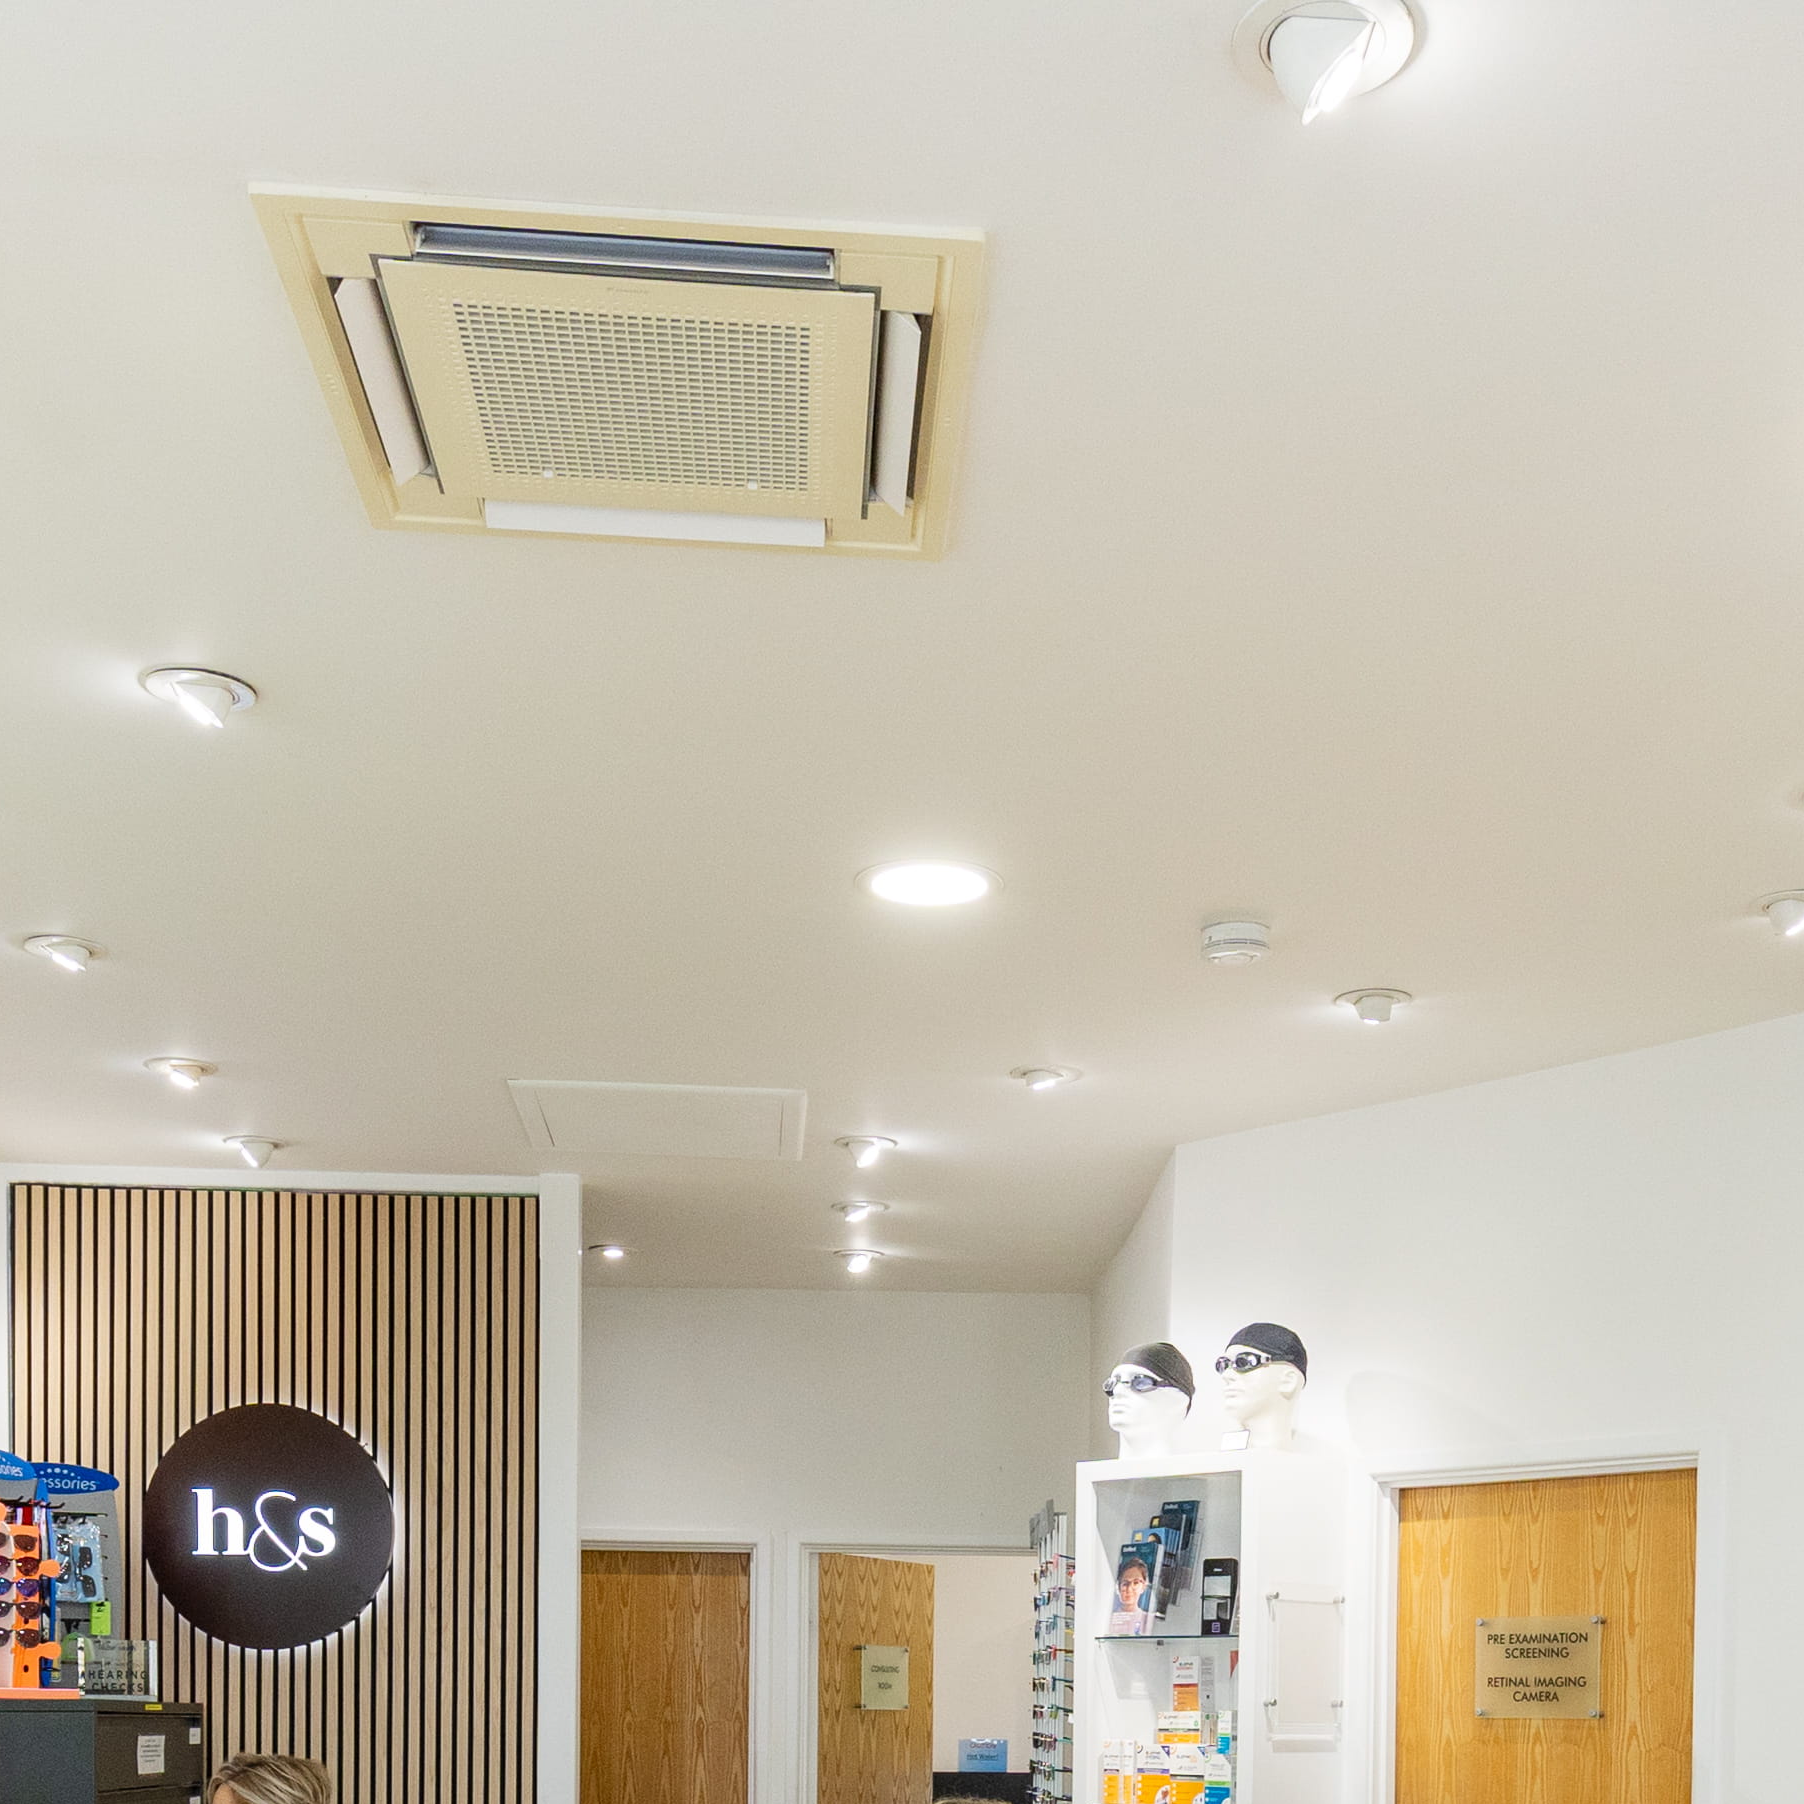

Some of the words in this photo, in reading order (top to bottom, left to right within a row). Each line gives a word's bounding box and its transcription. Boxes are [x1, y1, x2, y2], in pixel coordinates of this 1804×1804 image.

[45, 1478, 97, 1491] ssories
[190, 1487, 336, 1572] h&s
[1487, 1633, 1506, 1645] PRE
[1508, 1632, 1588, 1645] EXAMINATION
[1504, 1647, 1570, 1659] SCREENING
[88, 1670, 149, 1680] HEARING
[1487, 1676, 1530, 1688] RETINAL
[1534, 1676, 1587, 1688] IMAGING
[1512, 1691, 1560, 1702] CAMERA
